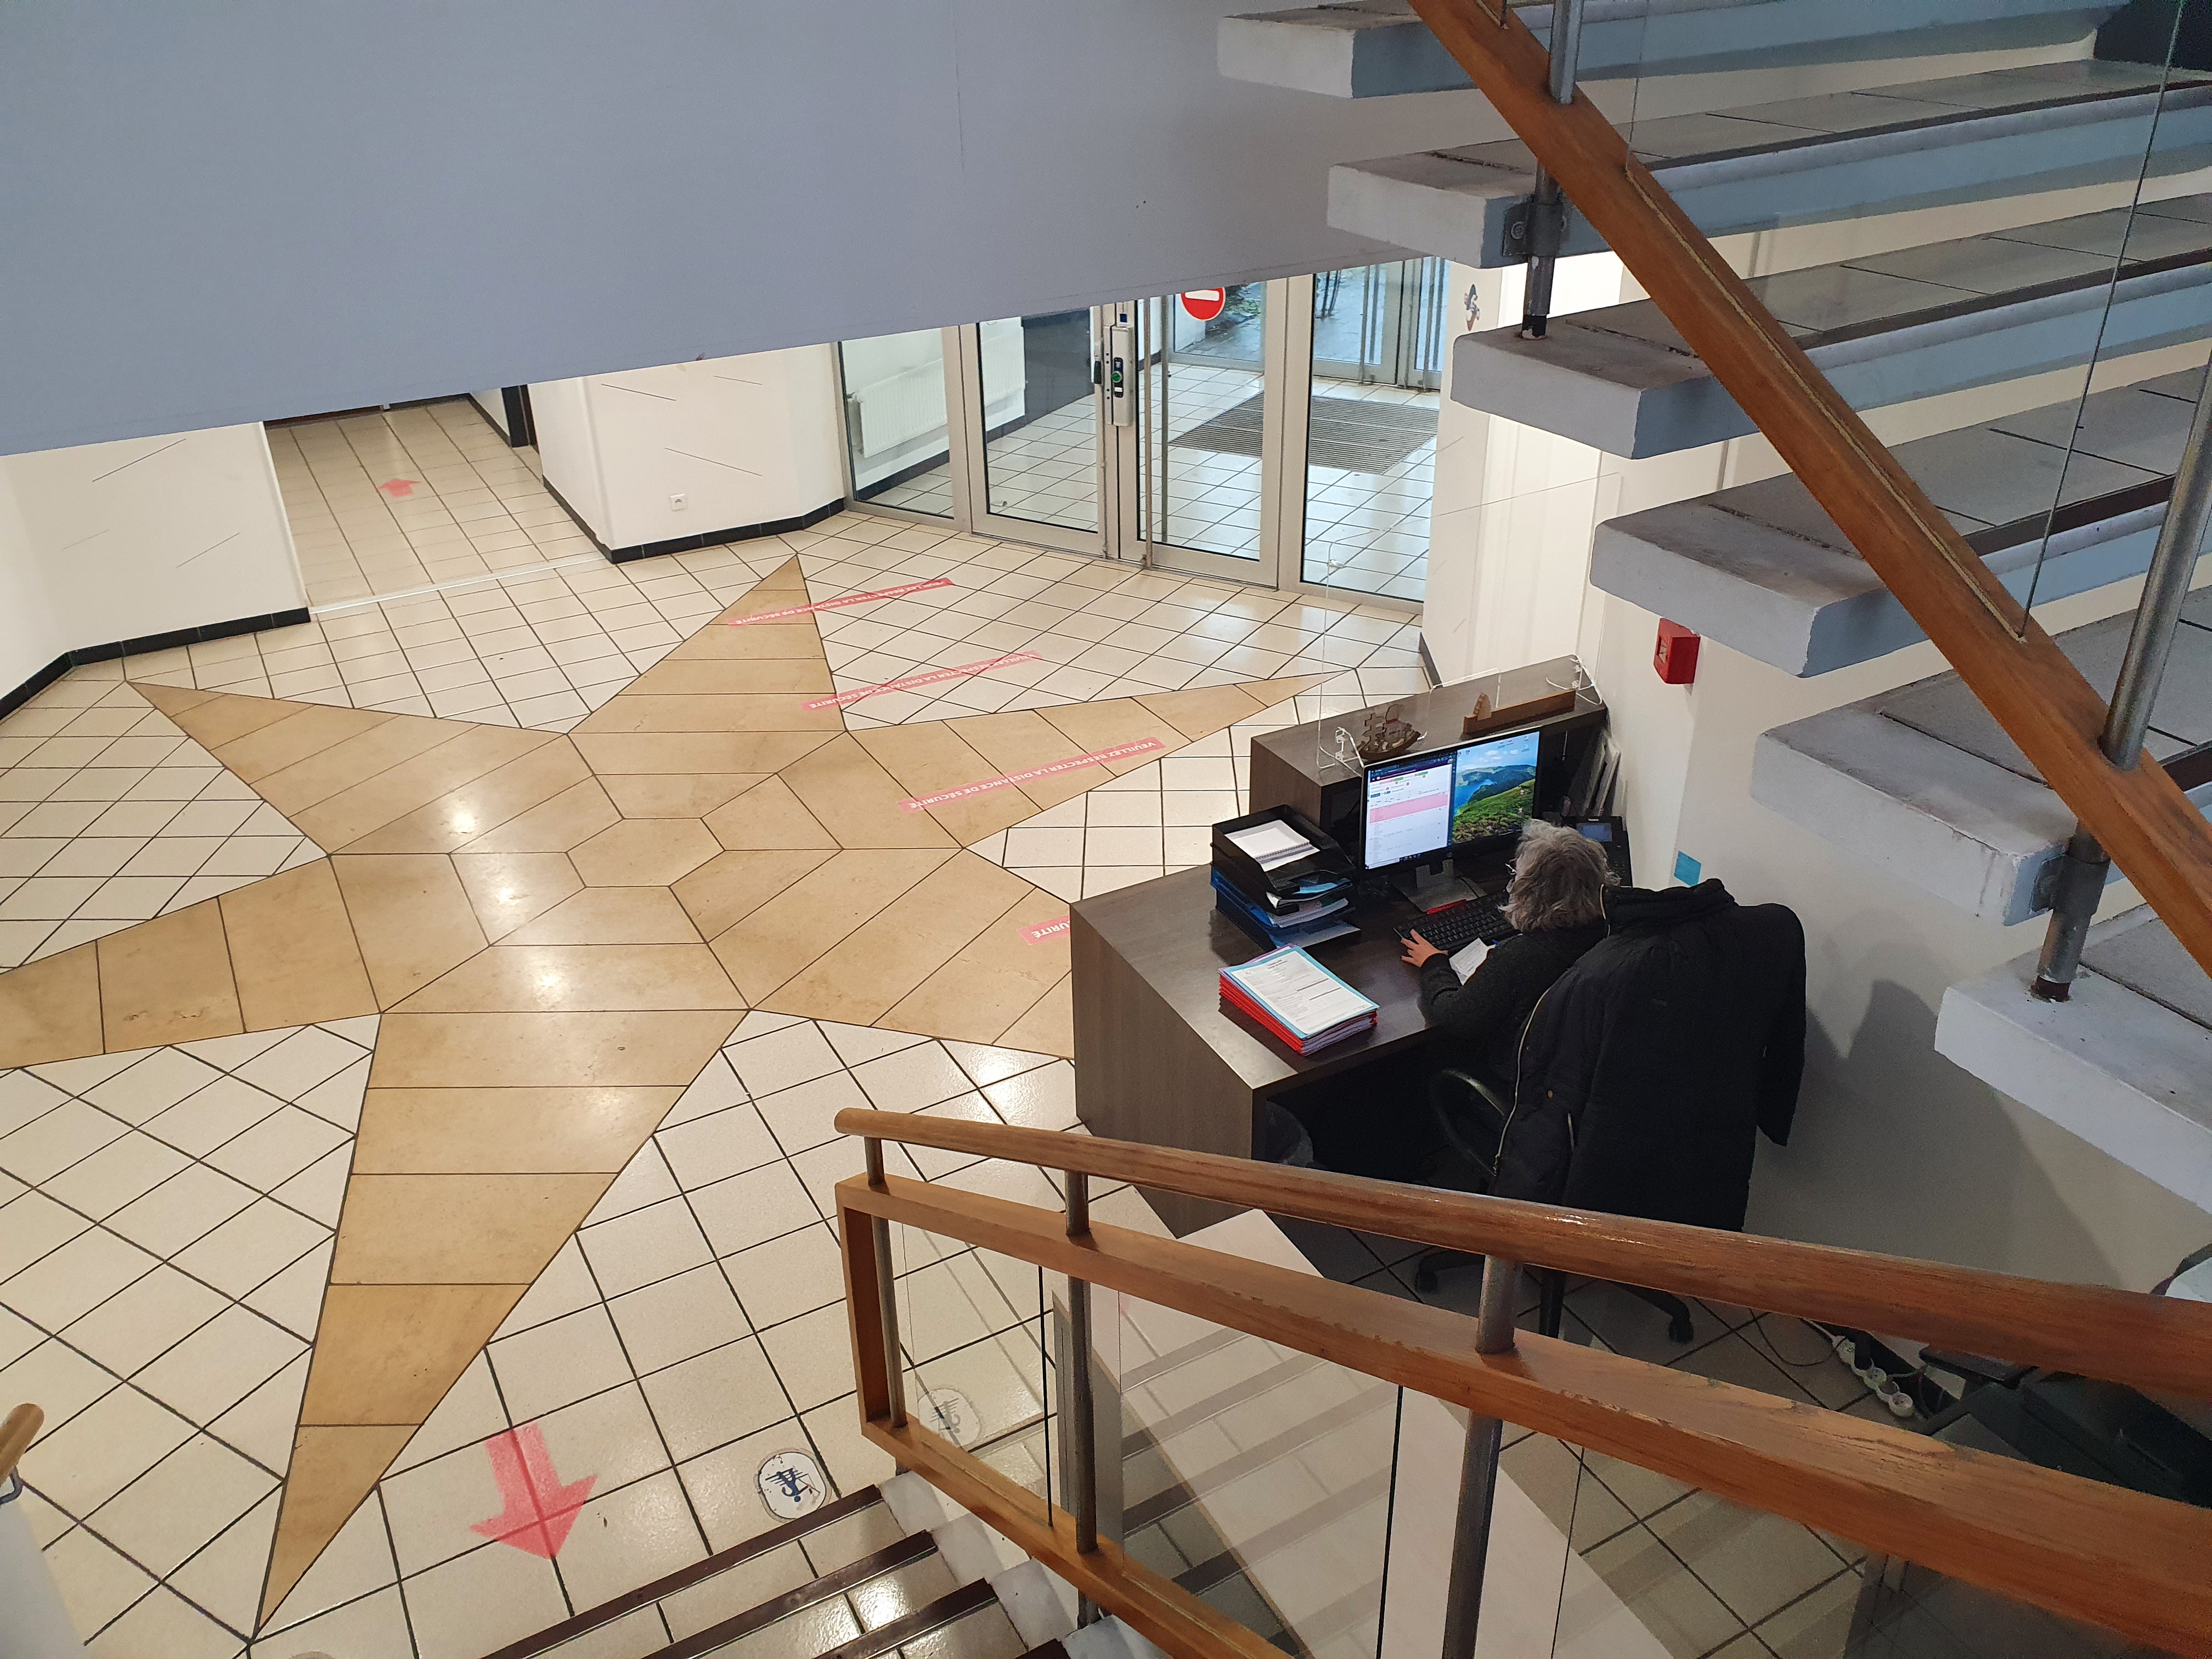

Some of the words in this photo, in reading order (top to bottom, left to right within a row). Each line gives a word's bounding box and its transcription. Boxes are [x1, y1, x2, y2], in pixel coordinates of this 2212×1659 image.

[1107, 741, 1156, 757] VEUILLEZ
[1048, 754, 1107, 771] RESPECTER
[979, 772, 1032, 789] DISTANCE
[963, 786, 979, 794] DE
[908, 790, 963, 809] SÉCURITÉ
